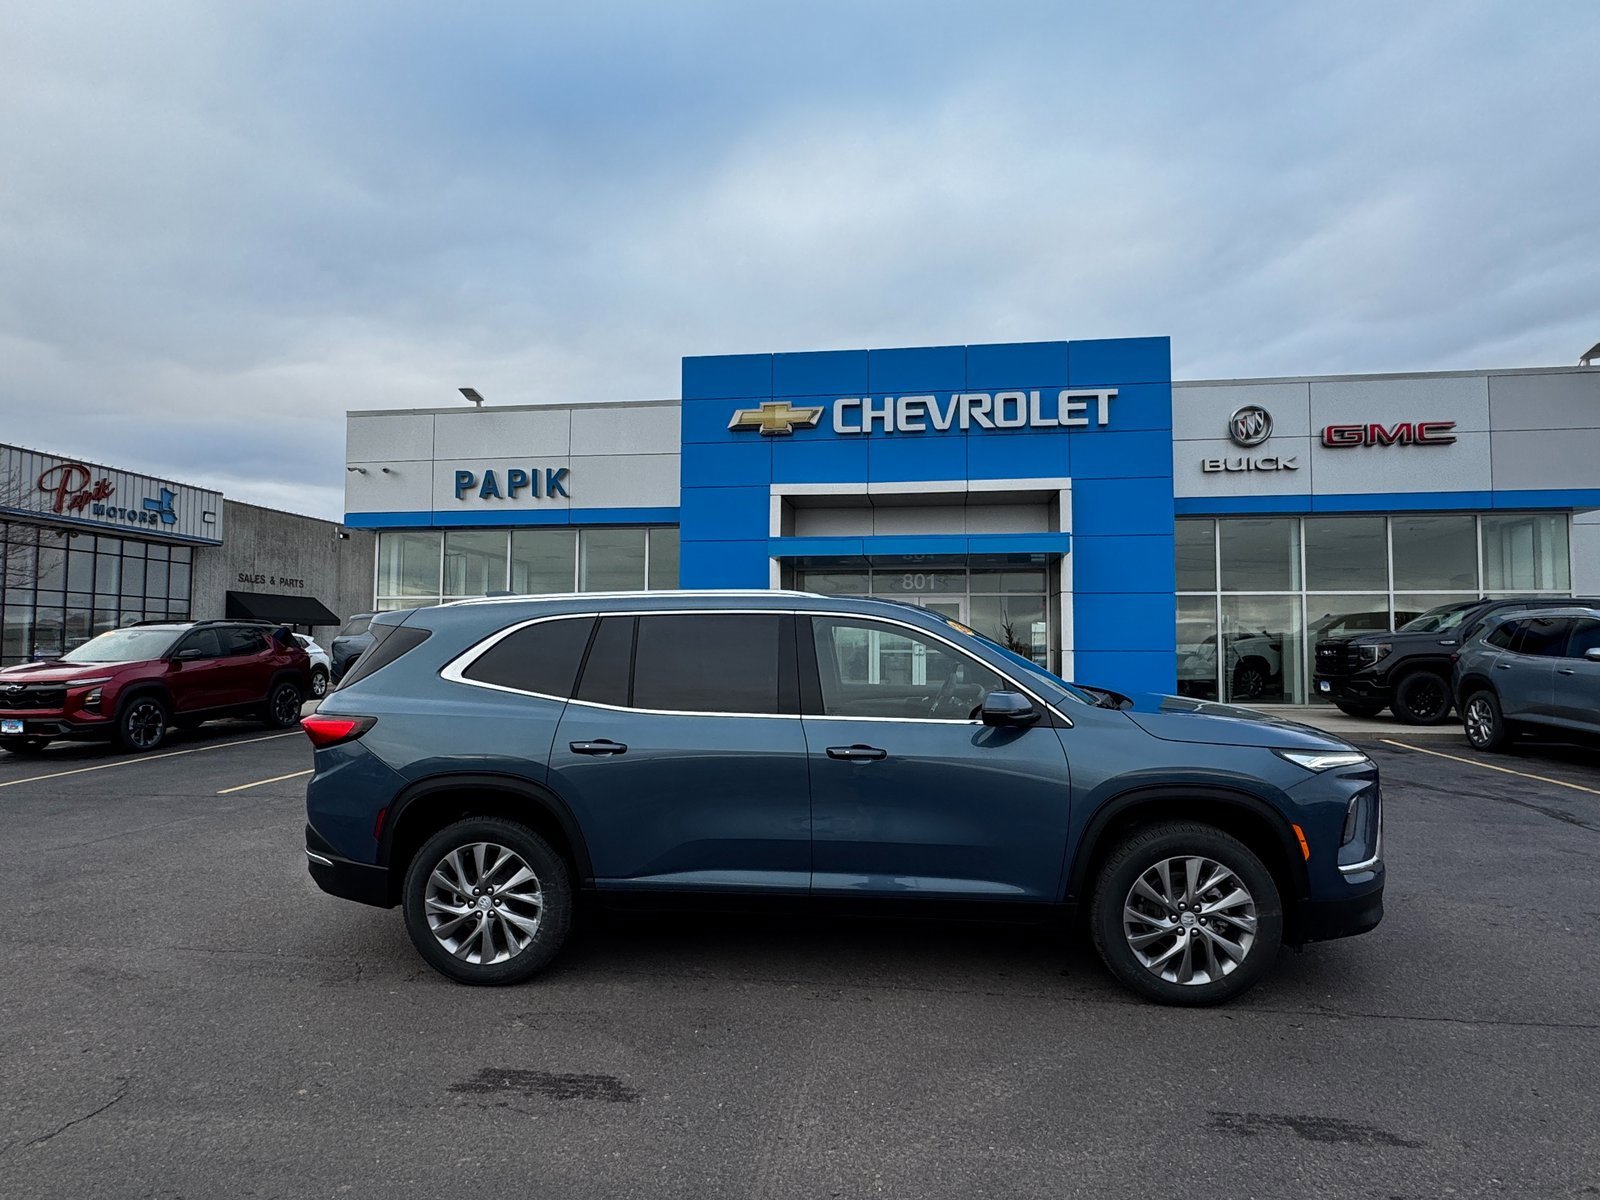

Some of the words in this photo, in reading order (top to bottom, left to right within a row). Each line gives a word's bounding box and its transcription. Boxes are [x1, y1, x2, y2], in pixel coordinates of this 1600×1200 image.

[832, 388, 1119, 434] CHEVROLET
[1321, 421, 1457, 449] GMC
[1201, 456, 1299, 473] BUICK
[37, 463, 116, 514] Papik
[455, 468, 571, 500] PAPIK
[92, 503, 159, 525] MOTORS
[238, 572, 266, 585] SALES
[269, 576, 276, 586] &
[279, 577, 305, 589] PARTS
[901, 573, 935, 590] 801
